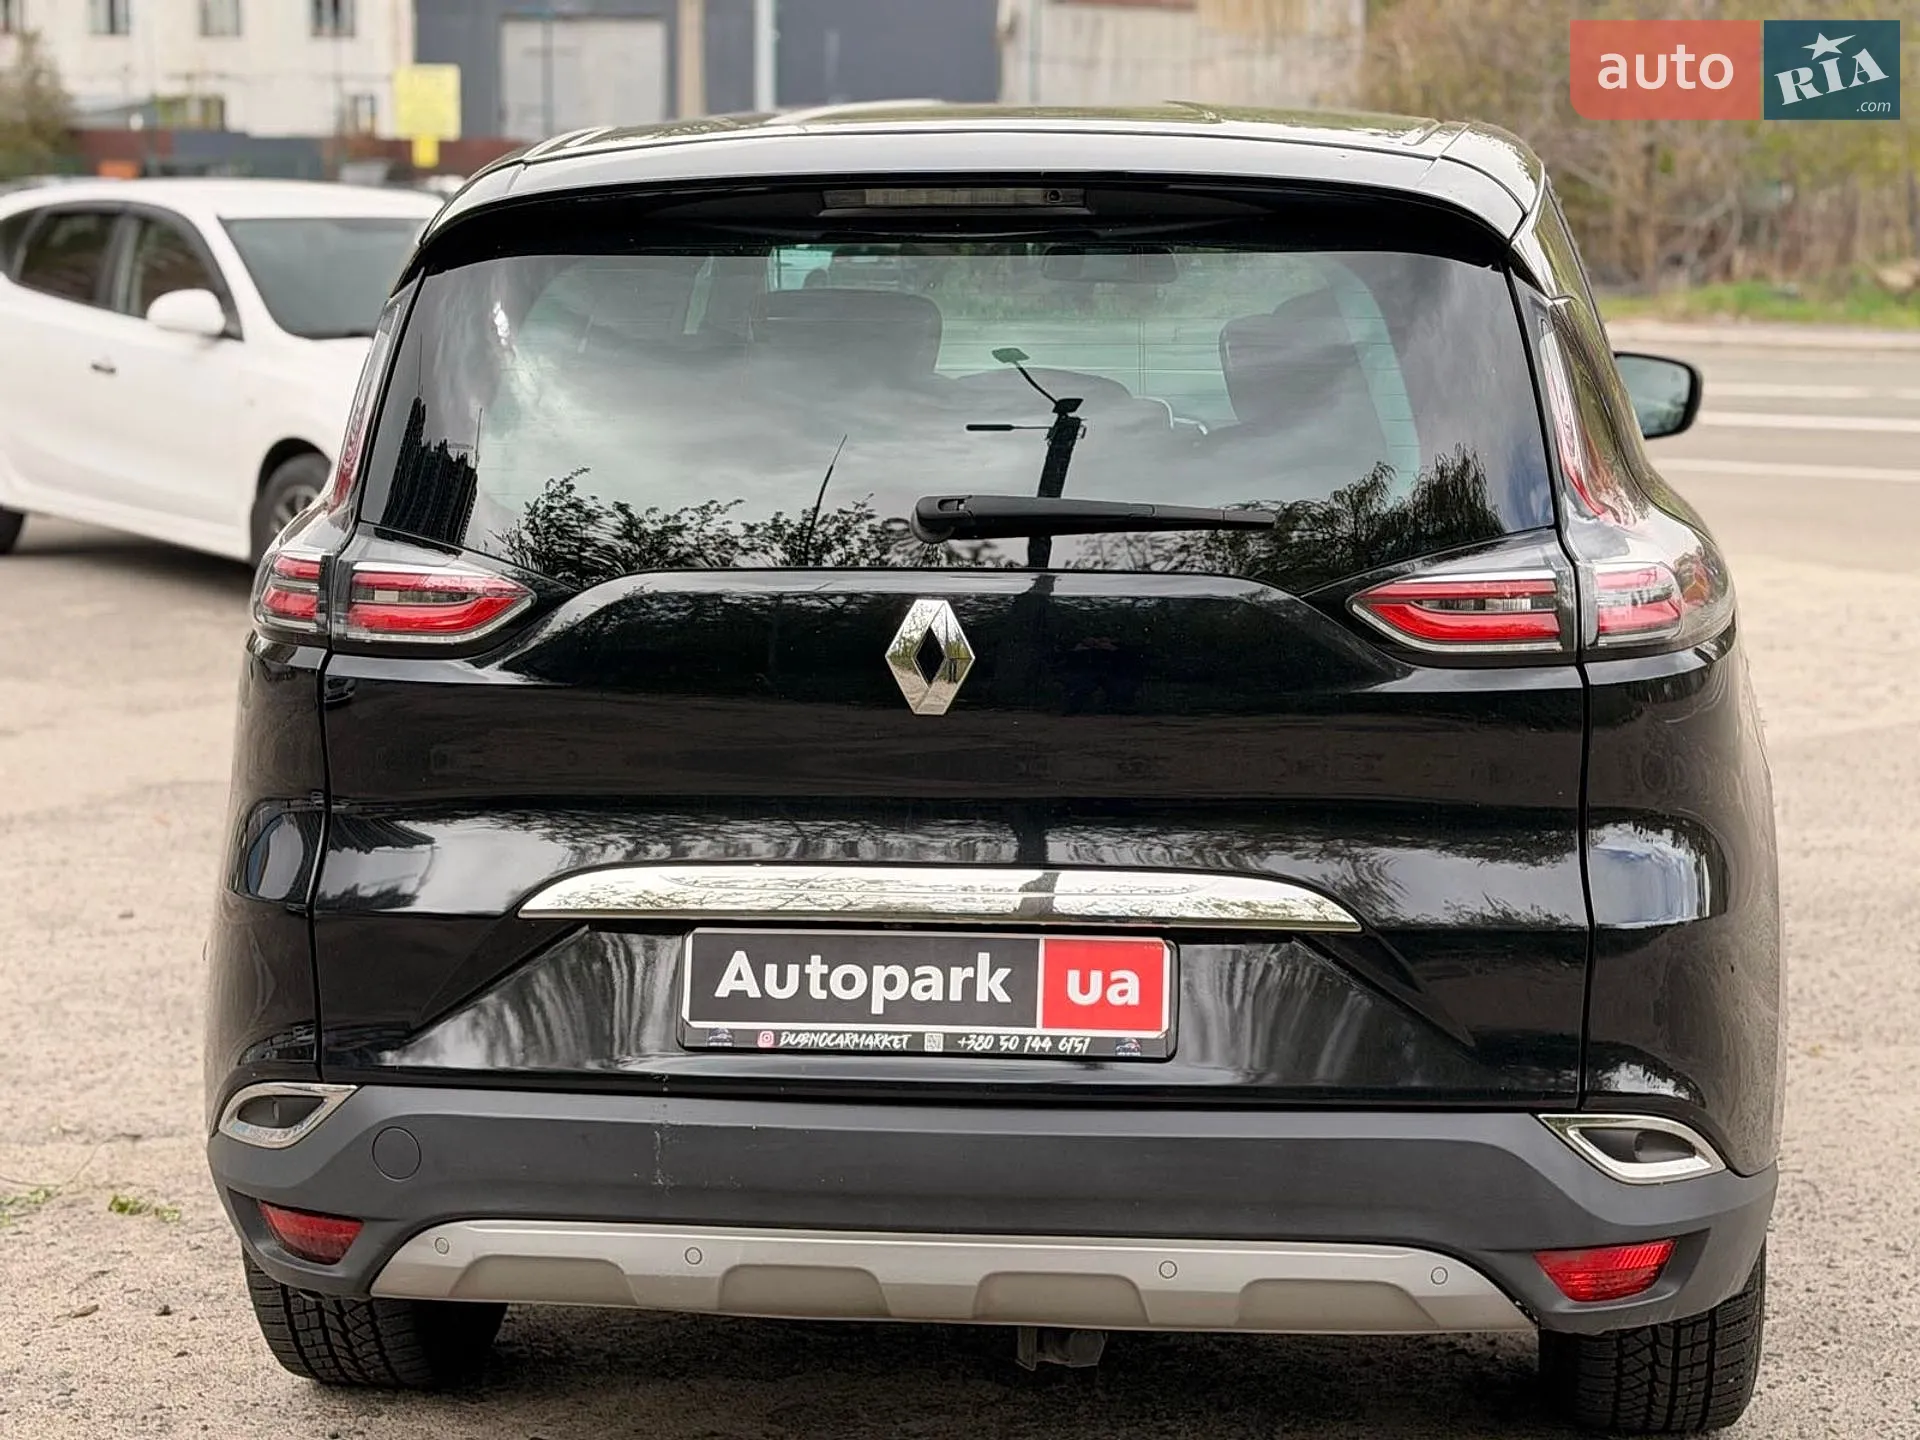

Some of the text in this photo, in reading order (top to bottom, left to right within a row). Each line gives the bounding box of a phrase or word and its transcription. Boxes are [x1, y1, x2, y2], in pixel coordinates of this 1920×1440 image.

[714, 950, 1140, 1014] Autopark ua
[957, 1034, 993, 1051] +380
[1000, 1036, 1019, 1051] 50
[1024, 1036, 1052, 1053] 144
